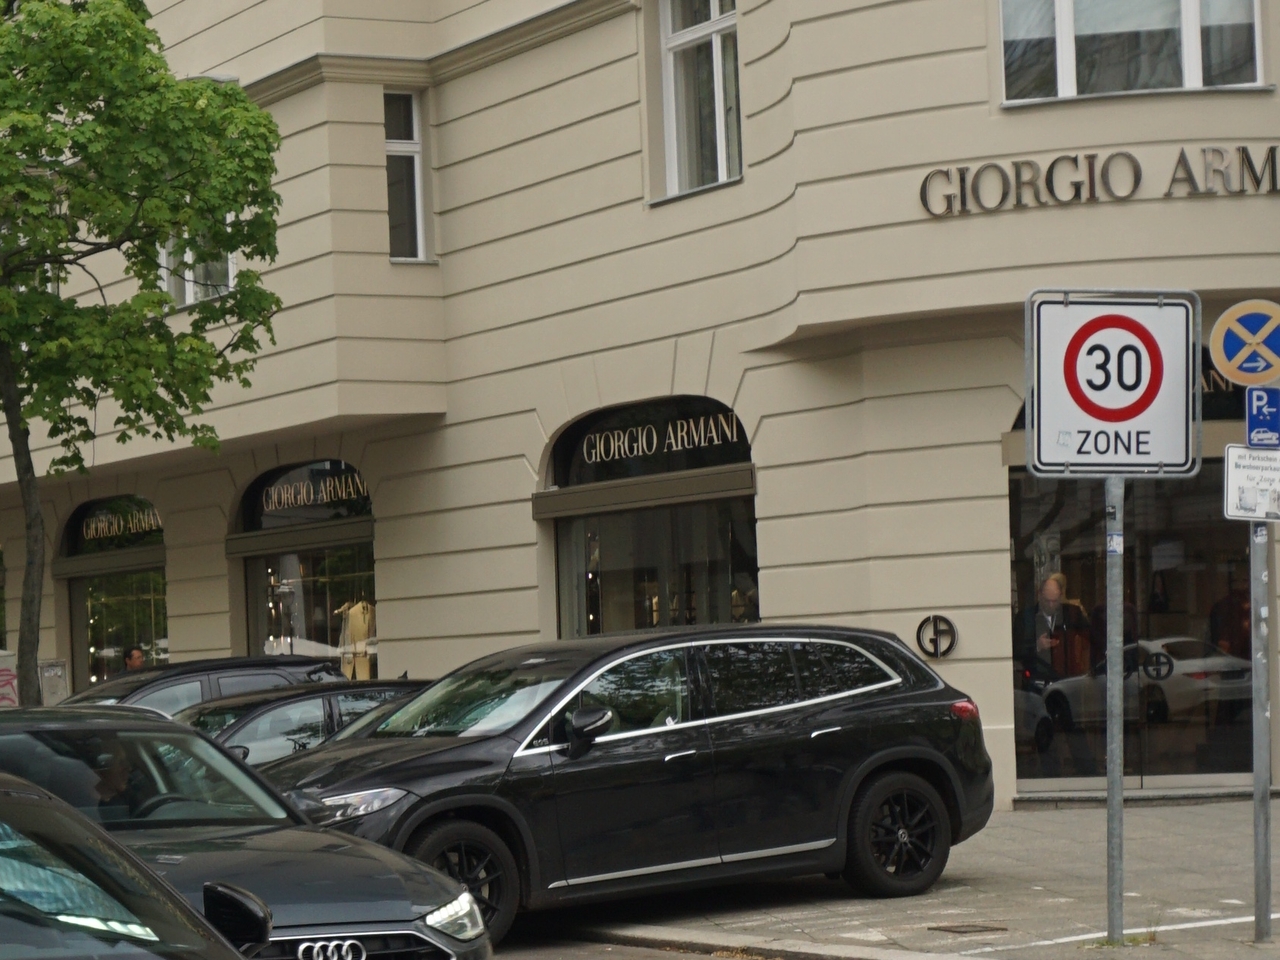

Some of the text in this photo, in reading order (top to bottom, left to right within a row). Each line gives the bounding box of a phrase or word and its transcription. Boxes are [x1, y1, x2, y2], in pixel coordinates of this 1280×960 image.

[919, 151, 1143, 218] GIORGIO
[1085, 343, 1142, 392] 30
[1252, 390, 1268, 415] P
[583, 411, 739, 463] GIORGIO ARMANI
[1076, 430, 1151, 456] ZONE
[262, 481, 314, 512] GIORGIO
[83, 514, 124, 540] GIORGIO
